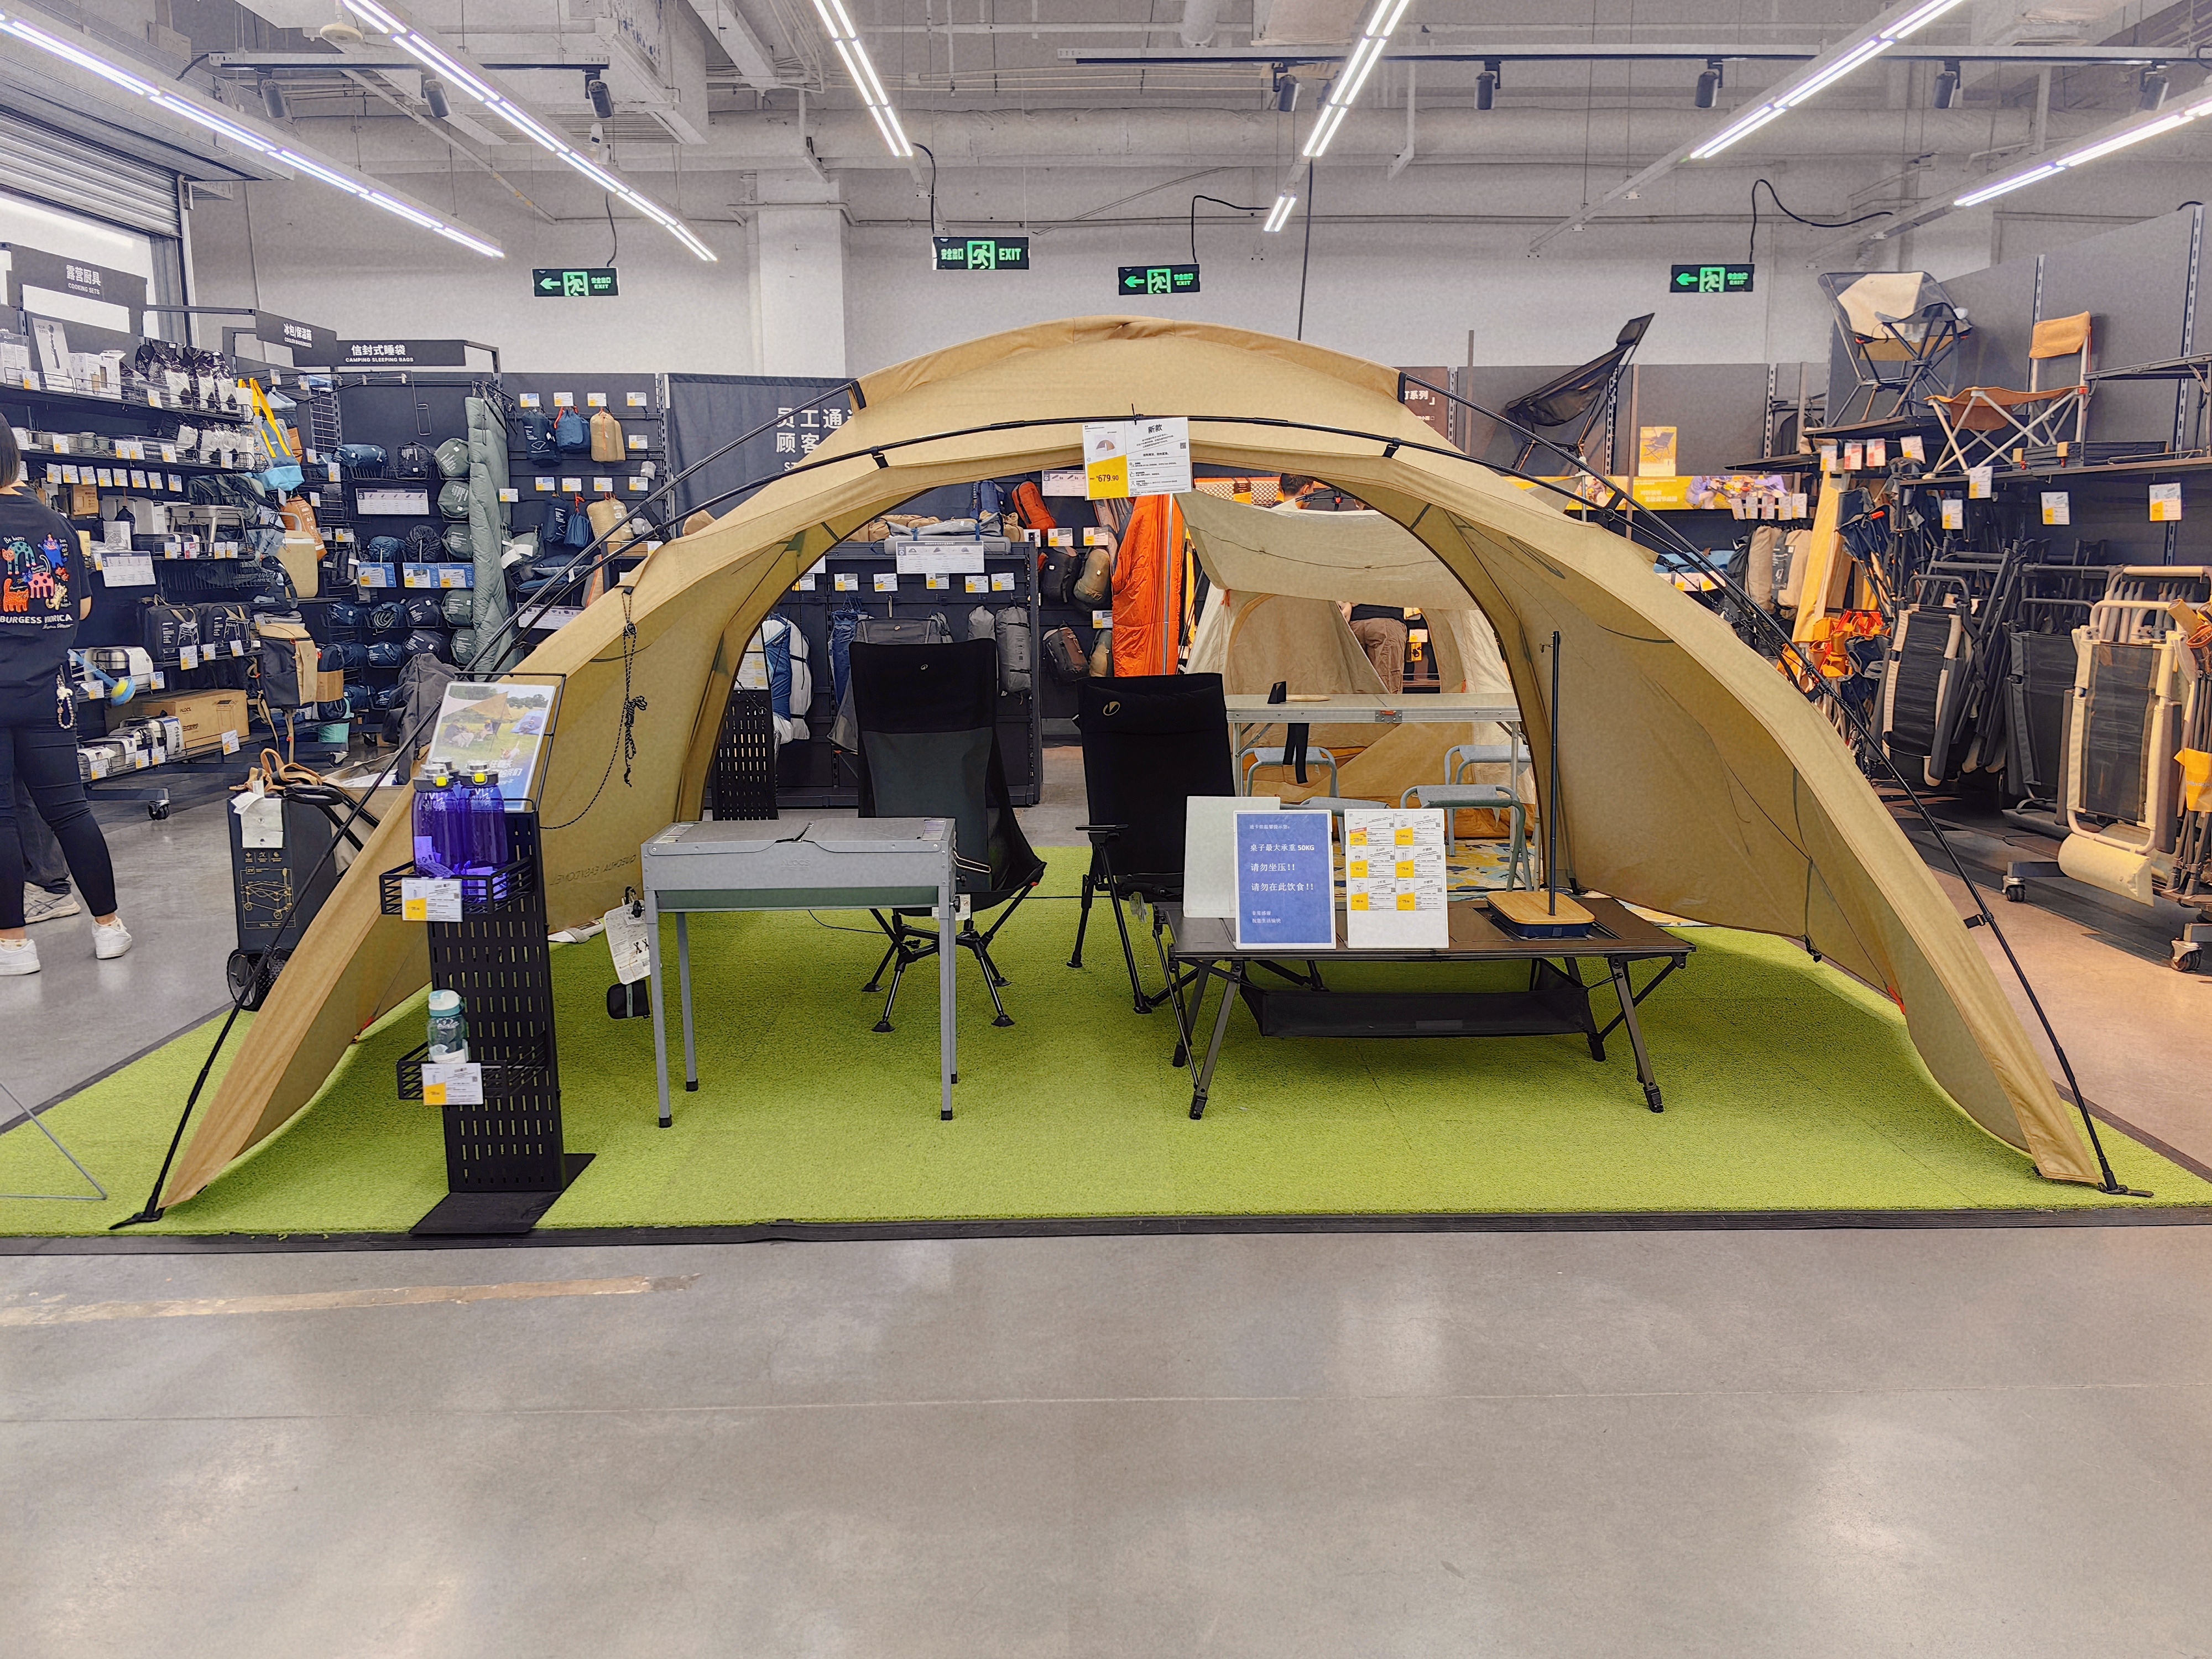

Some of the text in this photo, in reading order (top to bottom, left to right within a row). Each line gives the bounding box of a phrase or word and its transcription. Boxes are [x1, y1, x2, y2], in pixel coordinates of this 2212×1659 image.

[999, 248, 1021, 260] EXIT
[66, 264, 101, 286] 露营厨具
[68, 283, 88, 292] COOKING
[283, 322, 312, 341] 冰包/保温箱
[351, 344, 406, 356] 信封式睡袋
[1147, 424, 1162, 434] 新款
[0, 615, 42, 624] BURGESS
